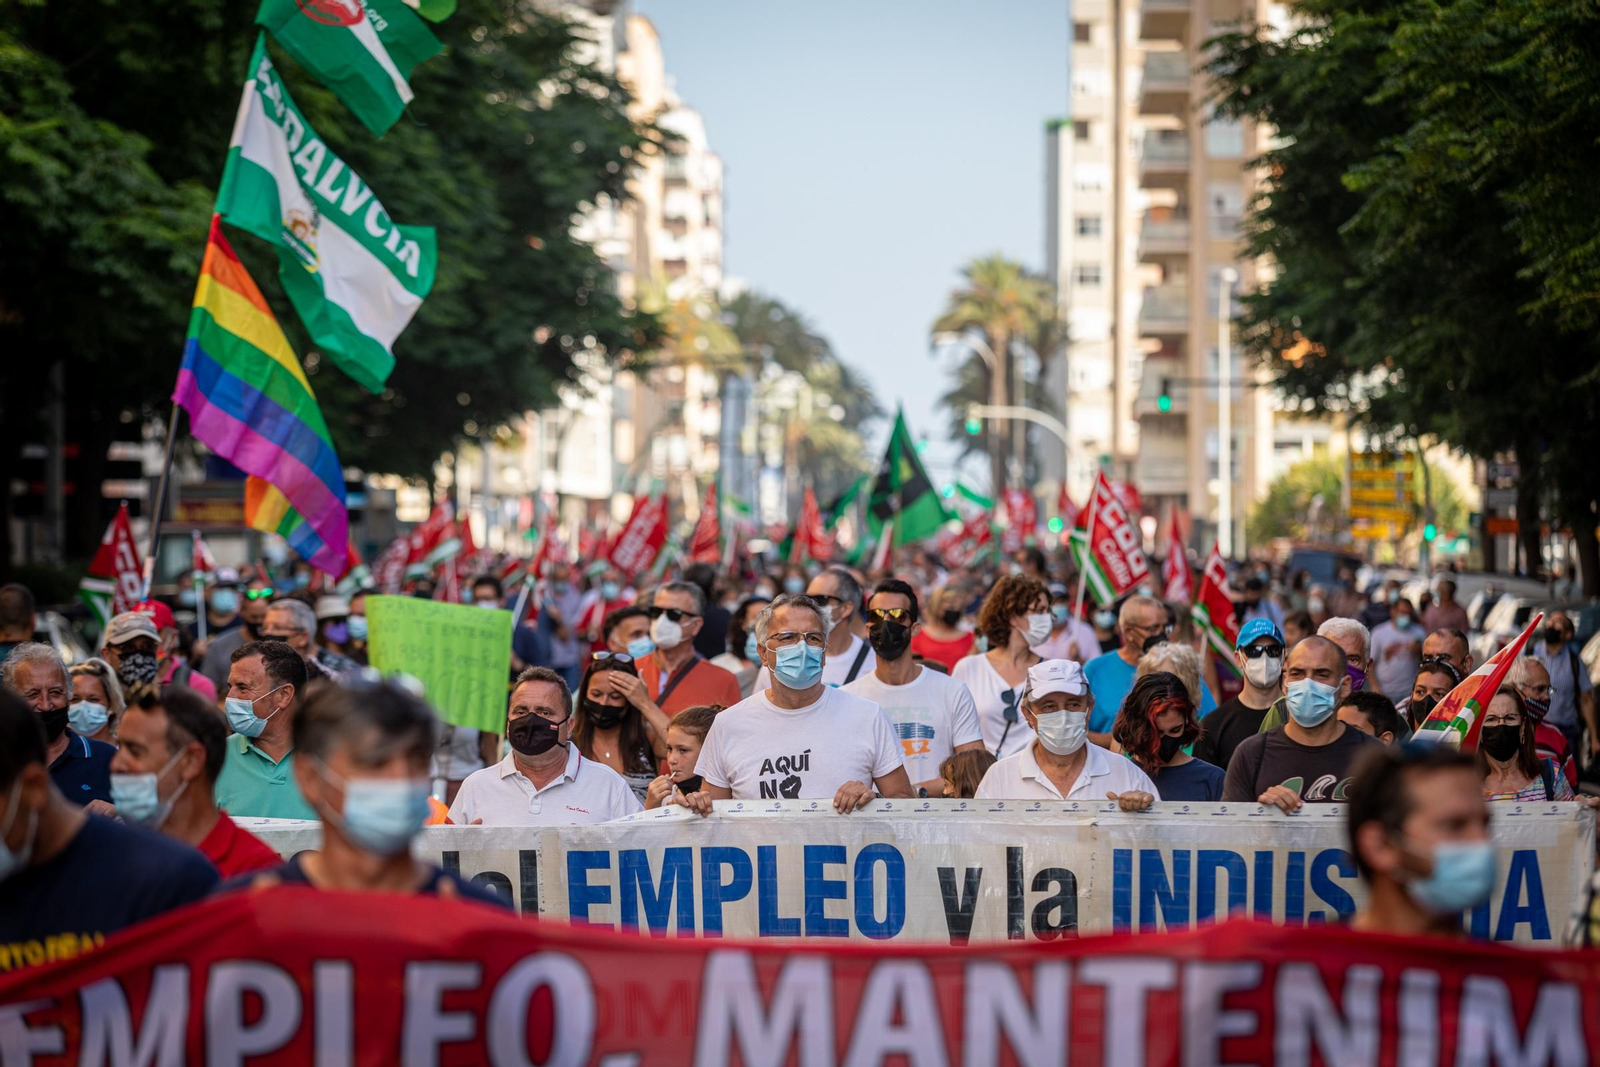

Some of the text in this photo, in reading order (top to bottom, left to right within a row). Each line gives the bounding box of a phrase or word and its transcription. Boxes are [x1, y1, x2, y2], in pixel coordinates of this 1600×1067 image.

[759, 748, 811, 776] AQUÍ
[567, 842, 905, 940] EMPLEO
[1006, 846, 1080, 942] la
[1113, 847, 1552, 941] INDUSA
[0, 951, 640, 1067] EMPLEO
[696, 949, 1588, 1067] MANTENIM
